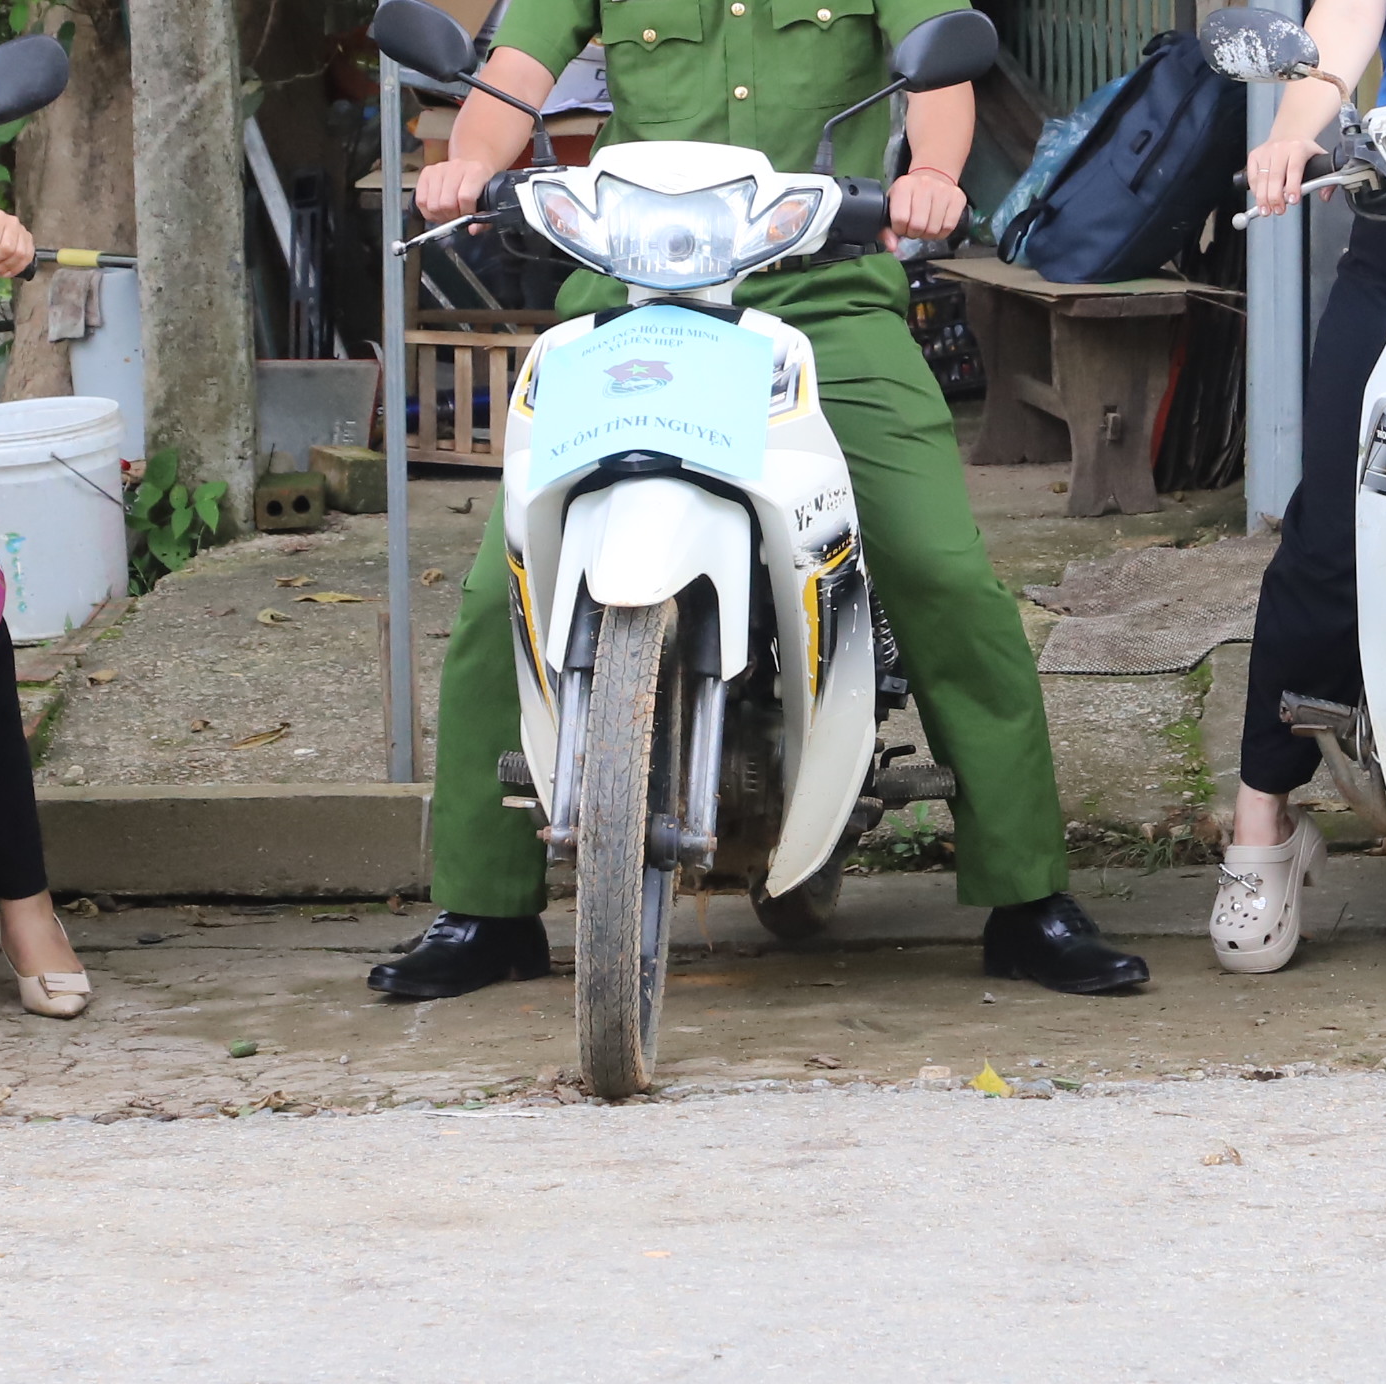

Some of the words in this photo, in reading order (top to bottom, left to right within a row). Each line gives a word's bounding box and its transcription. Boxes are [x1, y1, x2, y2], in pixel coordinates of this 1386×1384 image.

[640, 323, 658, 334] HỒ
[661, 325, 684, 336] CHÍ
[686, 327, 720, 343] MINH
[549, 439, 571, 460] XE
[603, 414, 648, 434] TÌNH
[654, 416, 733, 448] NGUYỆN
